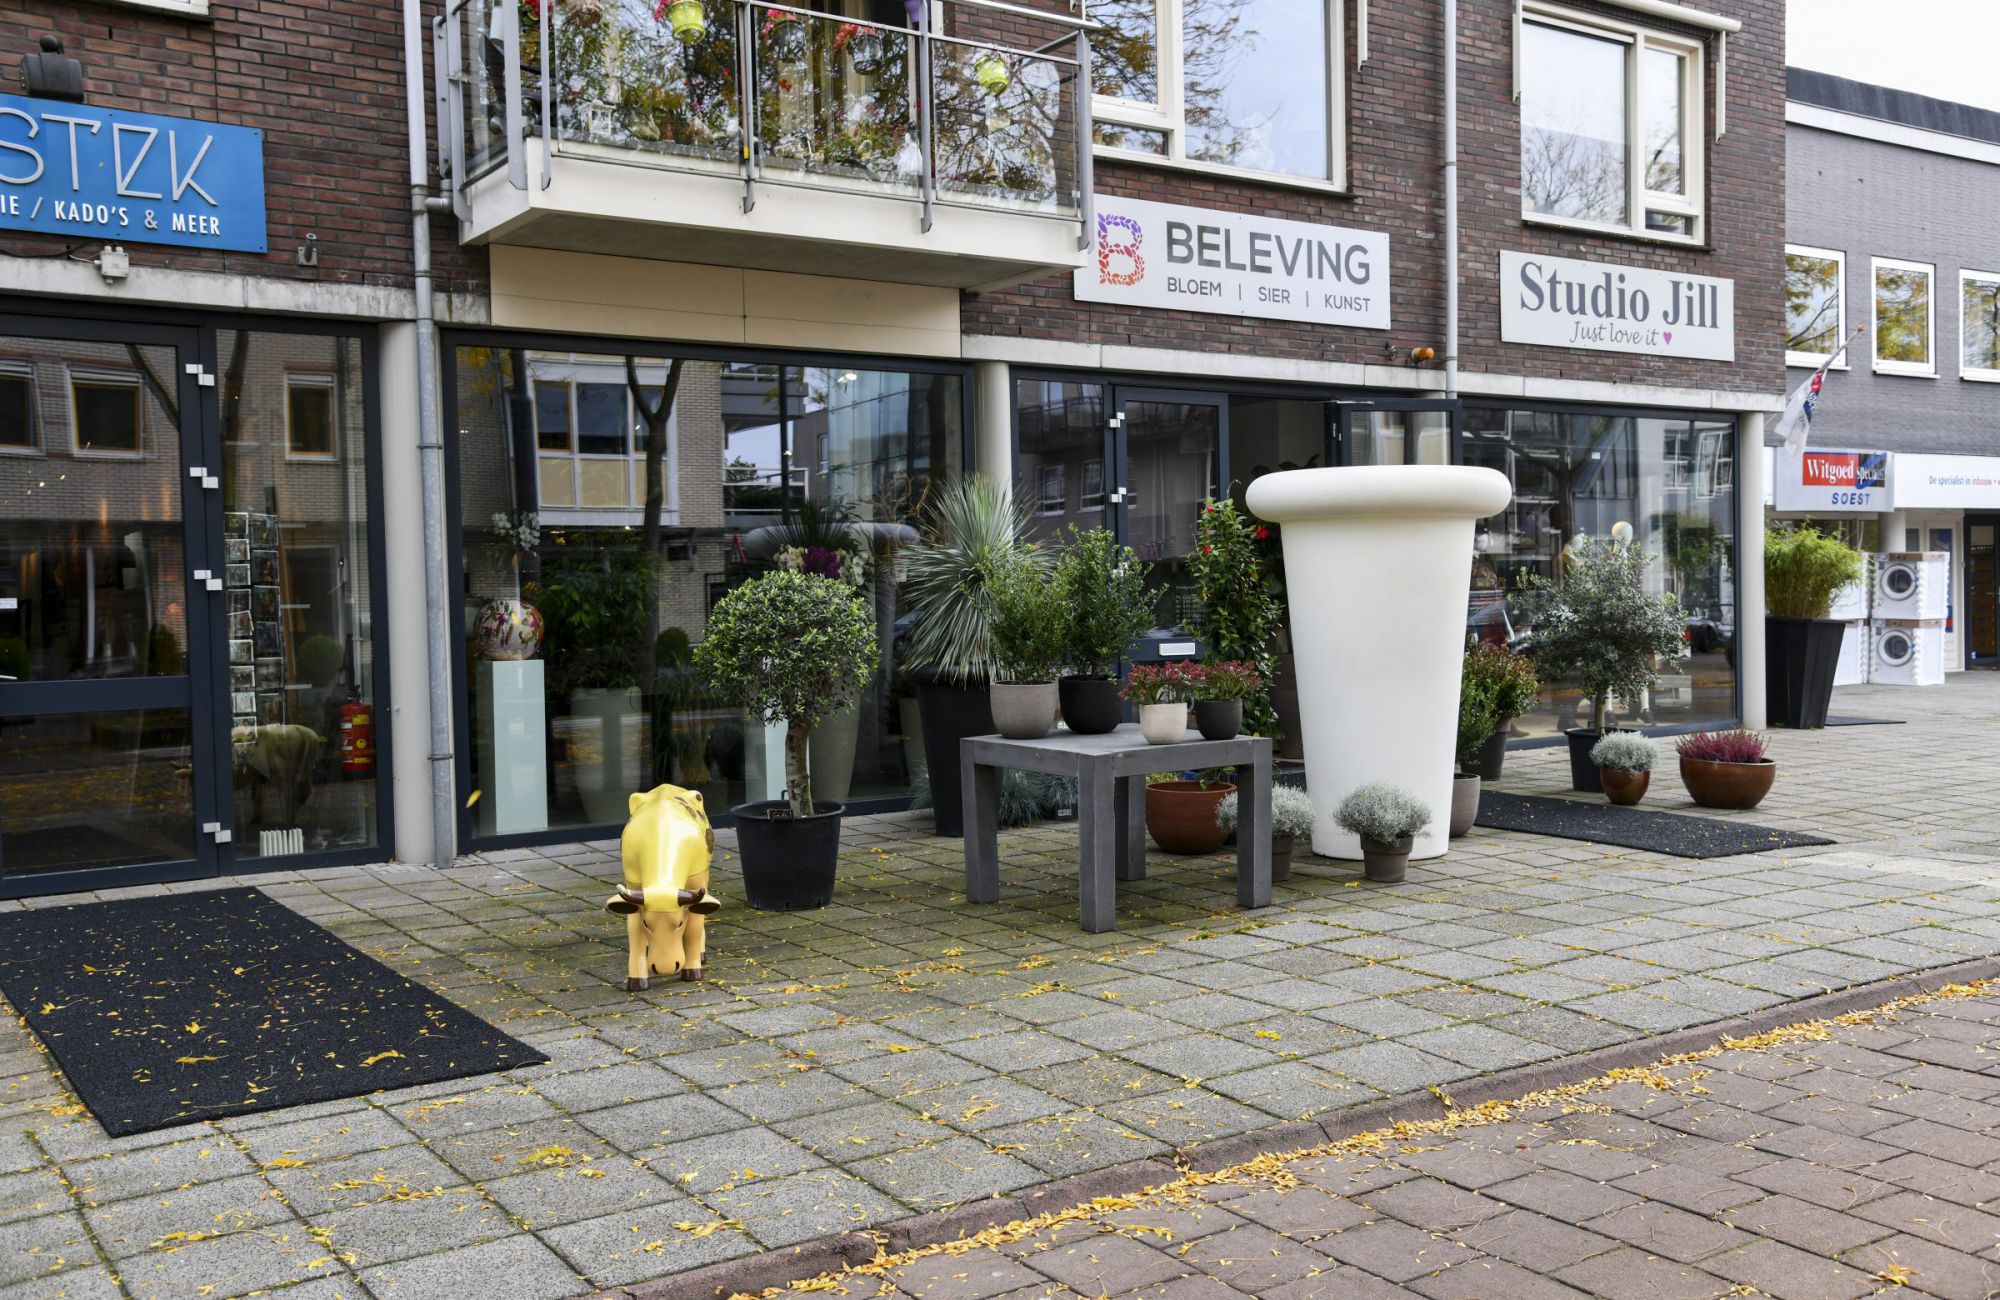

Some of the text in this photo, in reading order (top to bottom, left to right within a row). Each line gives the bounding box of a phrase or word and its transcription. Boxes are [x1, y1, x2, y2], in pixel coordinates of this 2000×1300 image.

[144, 209, 159, 230] &
[172, 213, 221, 236] MEER
[1166, 220, 1371, 286] BELEVING
[1167, 277, 1222, 297] BLOEM
[1258, 286, 1291, 304] SIER
[1324, 293, 1371, 312] KUNST
[1520, 261, 1720, 329] Studio Jill
[1569, 321, 1660, 346] Just love it
[1807, 458, 1854, 484] Witgoed
[1831, 492, 1871, 505] SOEST
